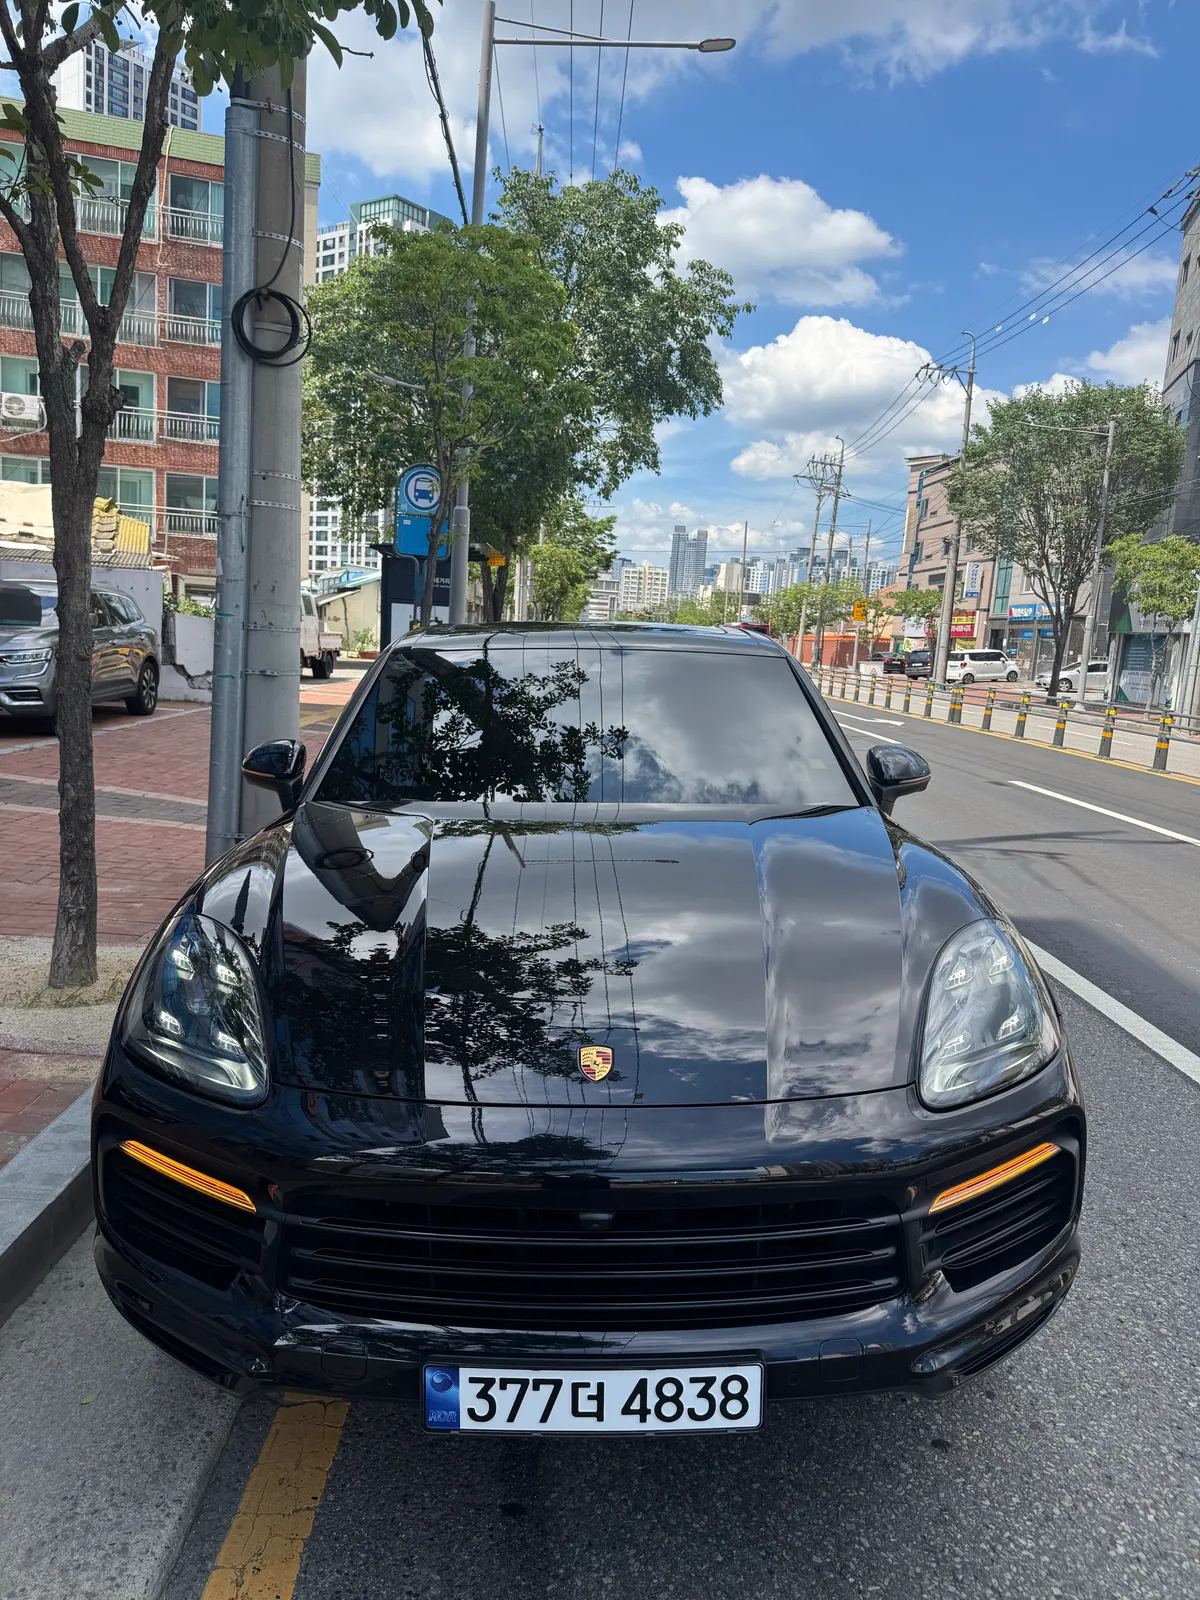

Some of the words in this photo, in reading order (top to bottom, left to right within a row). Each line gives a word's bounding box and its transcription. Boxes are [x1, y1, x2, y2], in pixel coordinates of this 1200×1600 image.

[467, 1376, 605, 1423] 377더
[621, 1374, 749, 1423] 4838
[428, 1409, 457, 1423] KOR
